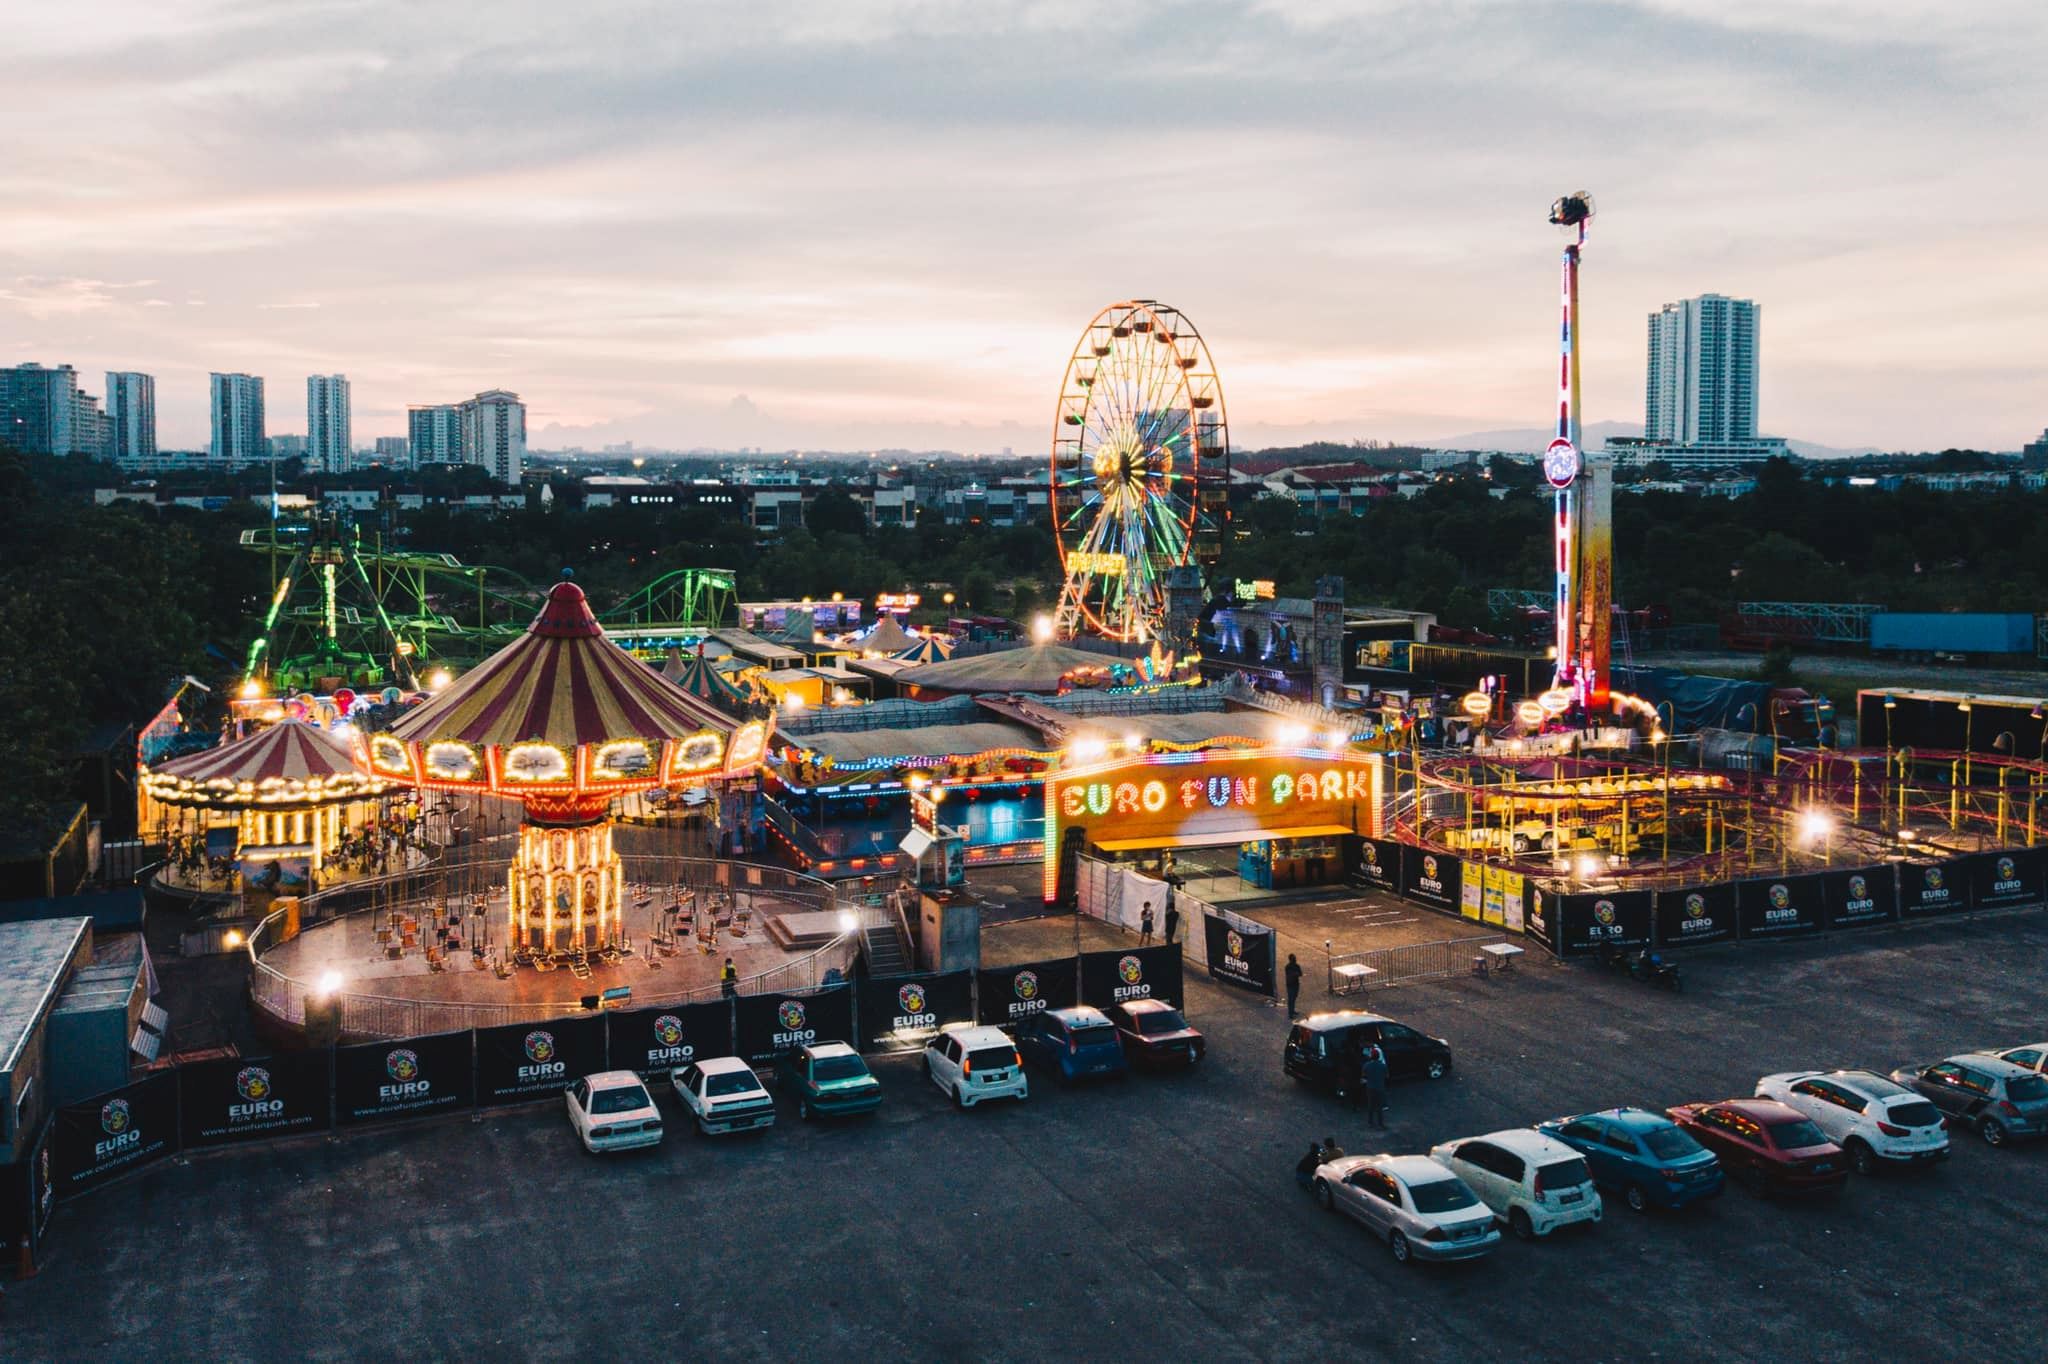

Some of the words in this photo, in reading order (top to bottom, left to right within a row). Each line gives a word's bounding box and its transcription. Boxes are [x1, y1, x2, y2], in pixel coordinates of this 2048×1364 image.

[1060, 780, 1168, 818] EURO
[1180, 776, 1258, 809] FUN
[1271, 769, 1368, 804] PARK
[1419, 877, 1443, 890] EURO
[1993, 880, 2022, 891] EURO
[1921, 889, 1949, 899] EURO
[1847, 899, 1874, 910] EURO
[1765, 908, 1798, 919] EURO
[1681, 917, 1713, 929] EURO
[1224, 955, 1249, 971] EURO
[1113, 983, 1152, 998] EURO
[1008, 999, 1048, 1013] EURO
[893, 1012, 937, 1028] EURO
[773, 1029, 816, 1044] EURO
[647, 1045, 695, 1061] EURO
[518, 1061, 566, 1078] EURO
[379, 1079, 431, 1097] EURO
[228, 1099, 284, 1117] EURO
[95, 1128, 141, 1155] EURO
